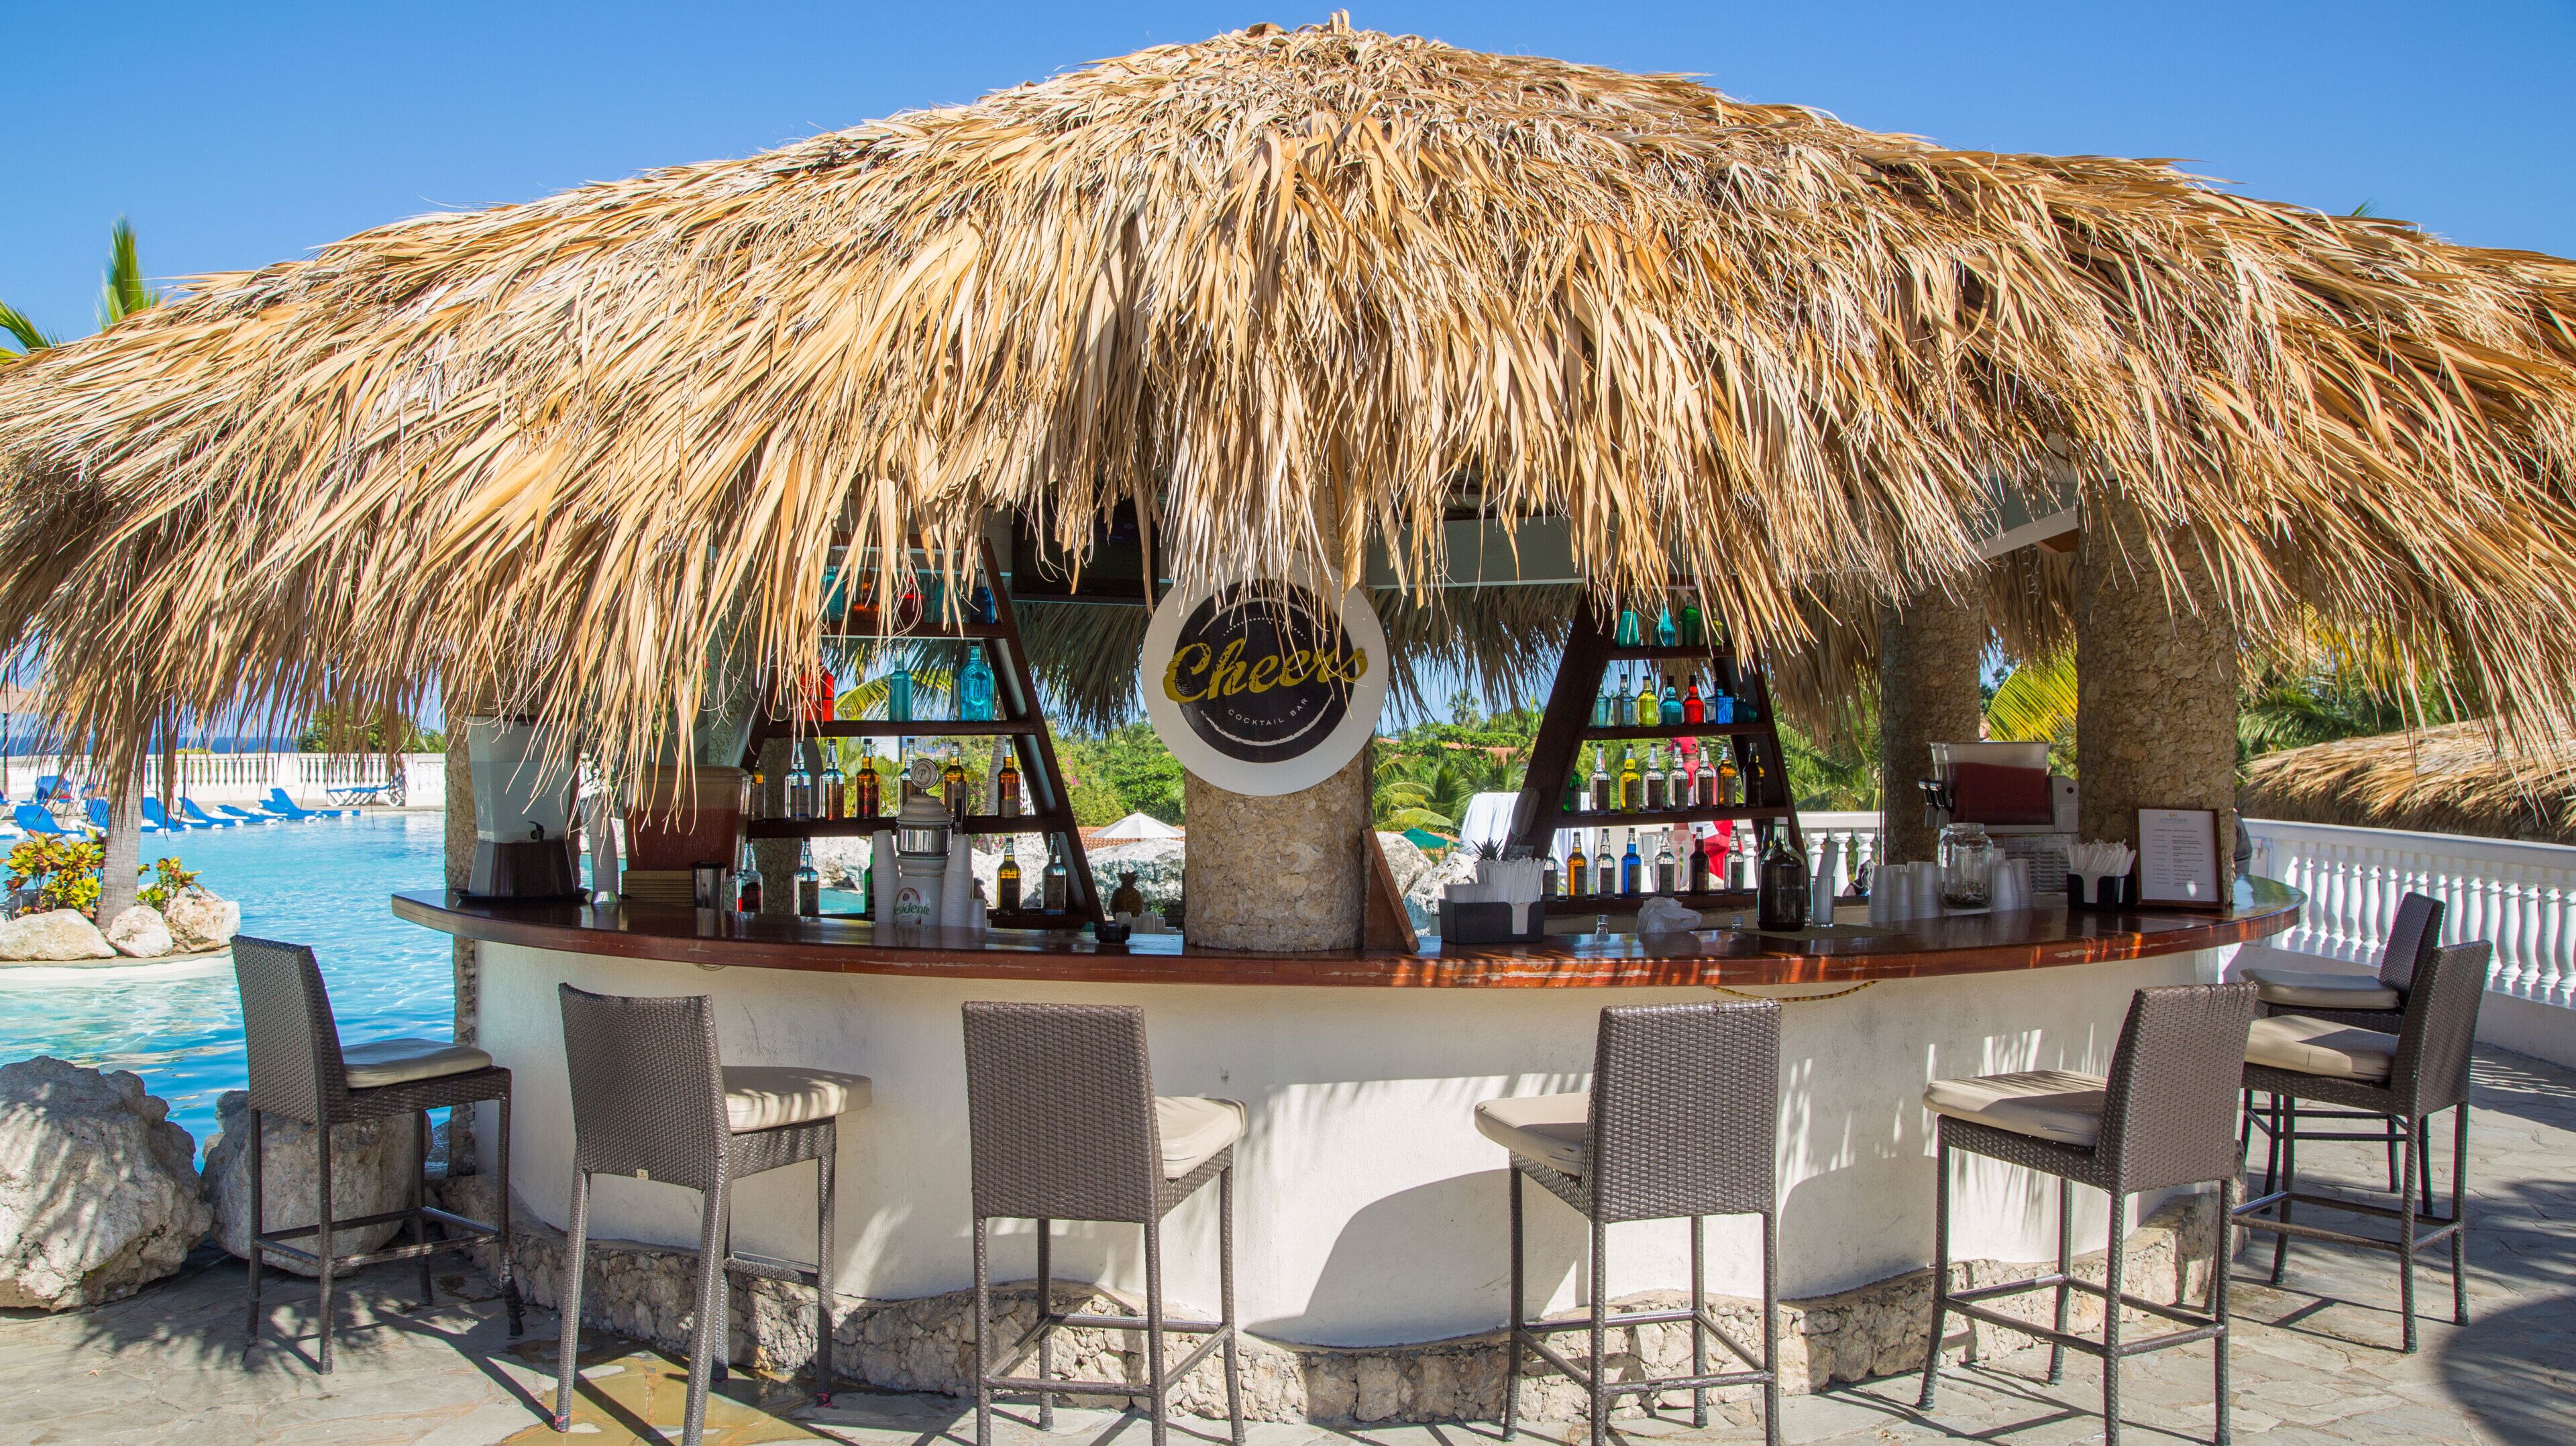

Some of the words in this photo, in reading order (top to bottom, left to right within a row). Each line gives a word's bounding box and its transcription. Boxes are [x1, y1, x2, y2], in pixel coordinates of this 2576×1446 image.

[1163, 638, 1368, 703] Cheers
[1228, 710, 1284, 726] COCKTAIL
[1290, 698, 1309, 716] BAR
